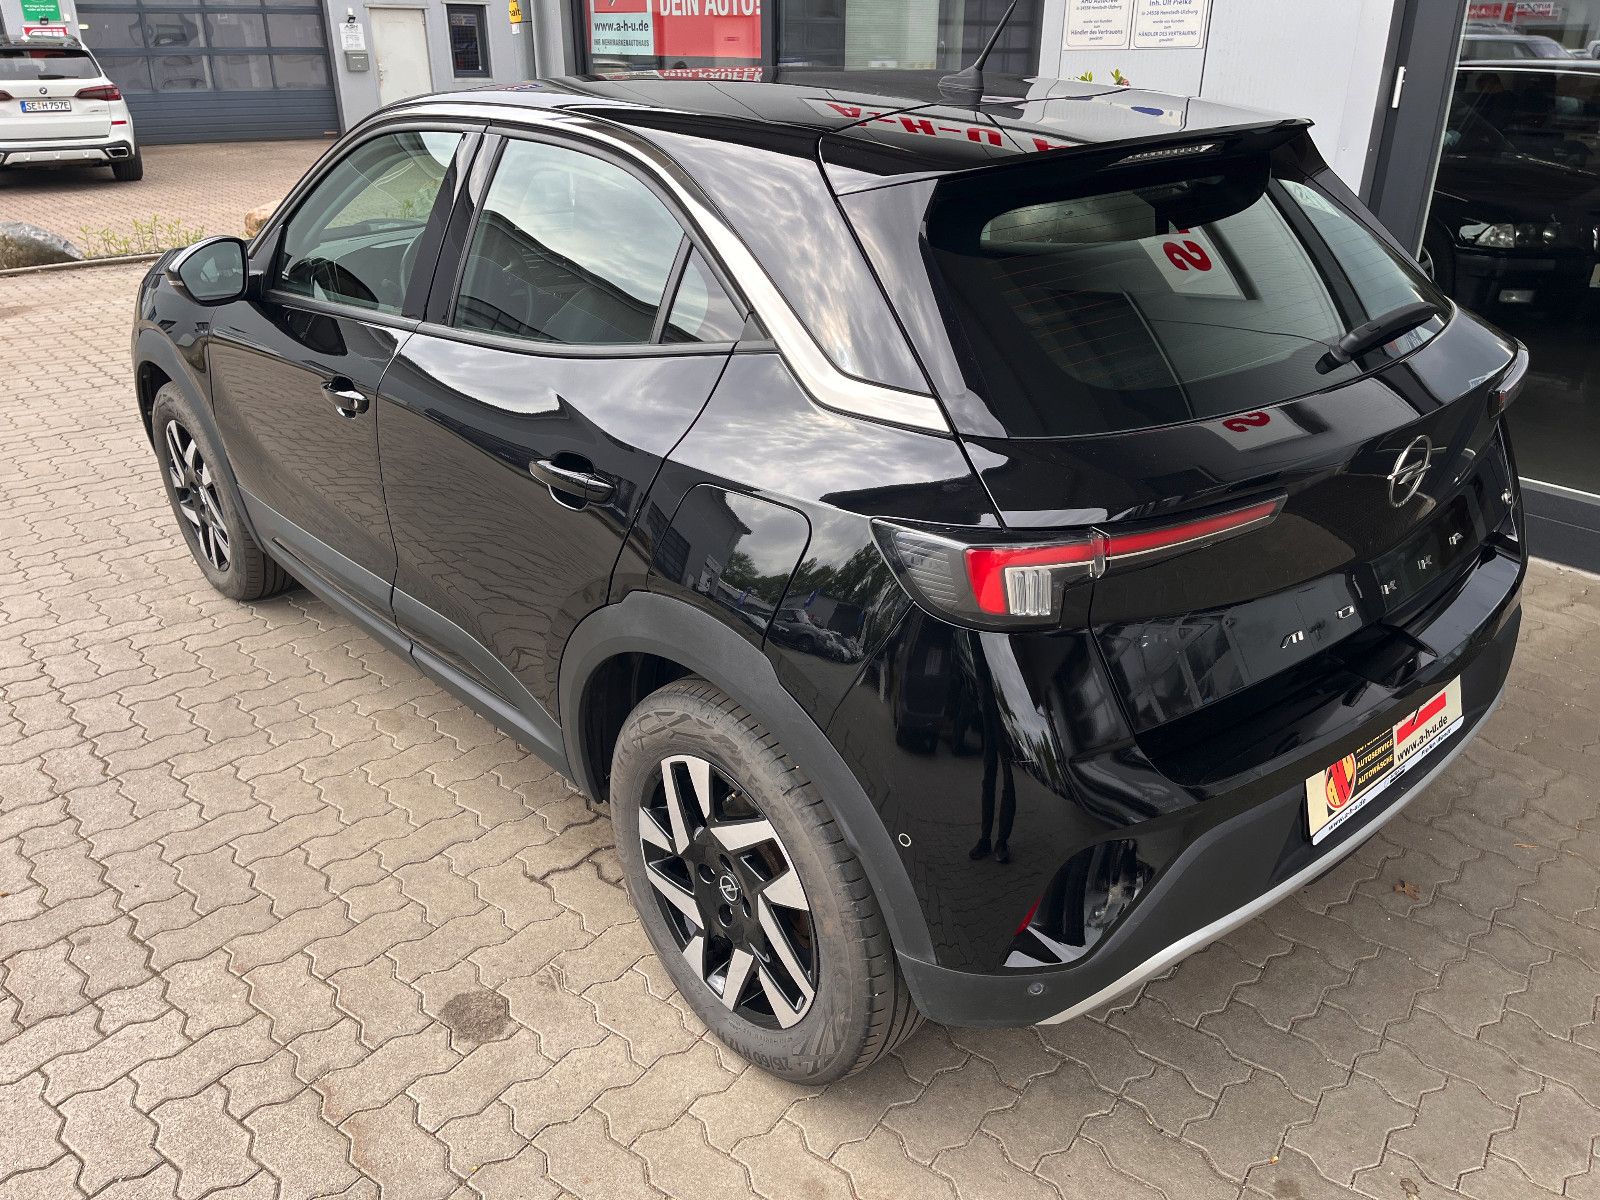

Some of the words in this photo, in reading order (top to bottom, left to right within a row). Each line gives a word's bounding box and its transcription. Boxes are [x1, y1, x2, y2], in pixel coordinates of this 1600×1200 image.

[594, 20, 649, 31] www.a-h-u.de
[26, 102, 38, 111] SE
[1397, 714, 1448, 762] www.a-h-u.de
[1357, 739, 1393, 769] AUTOSERVICE
[1357, 754, 1393, 786] AUTOWÄSCHE
